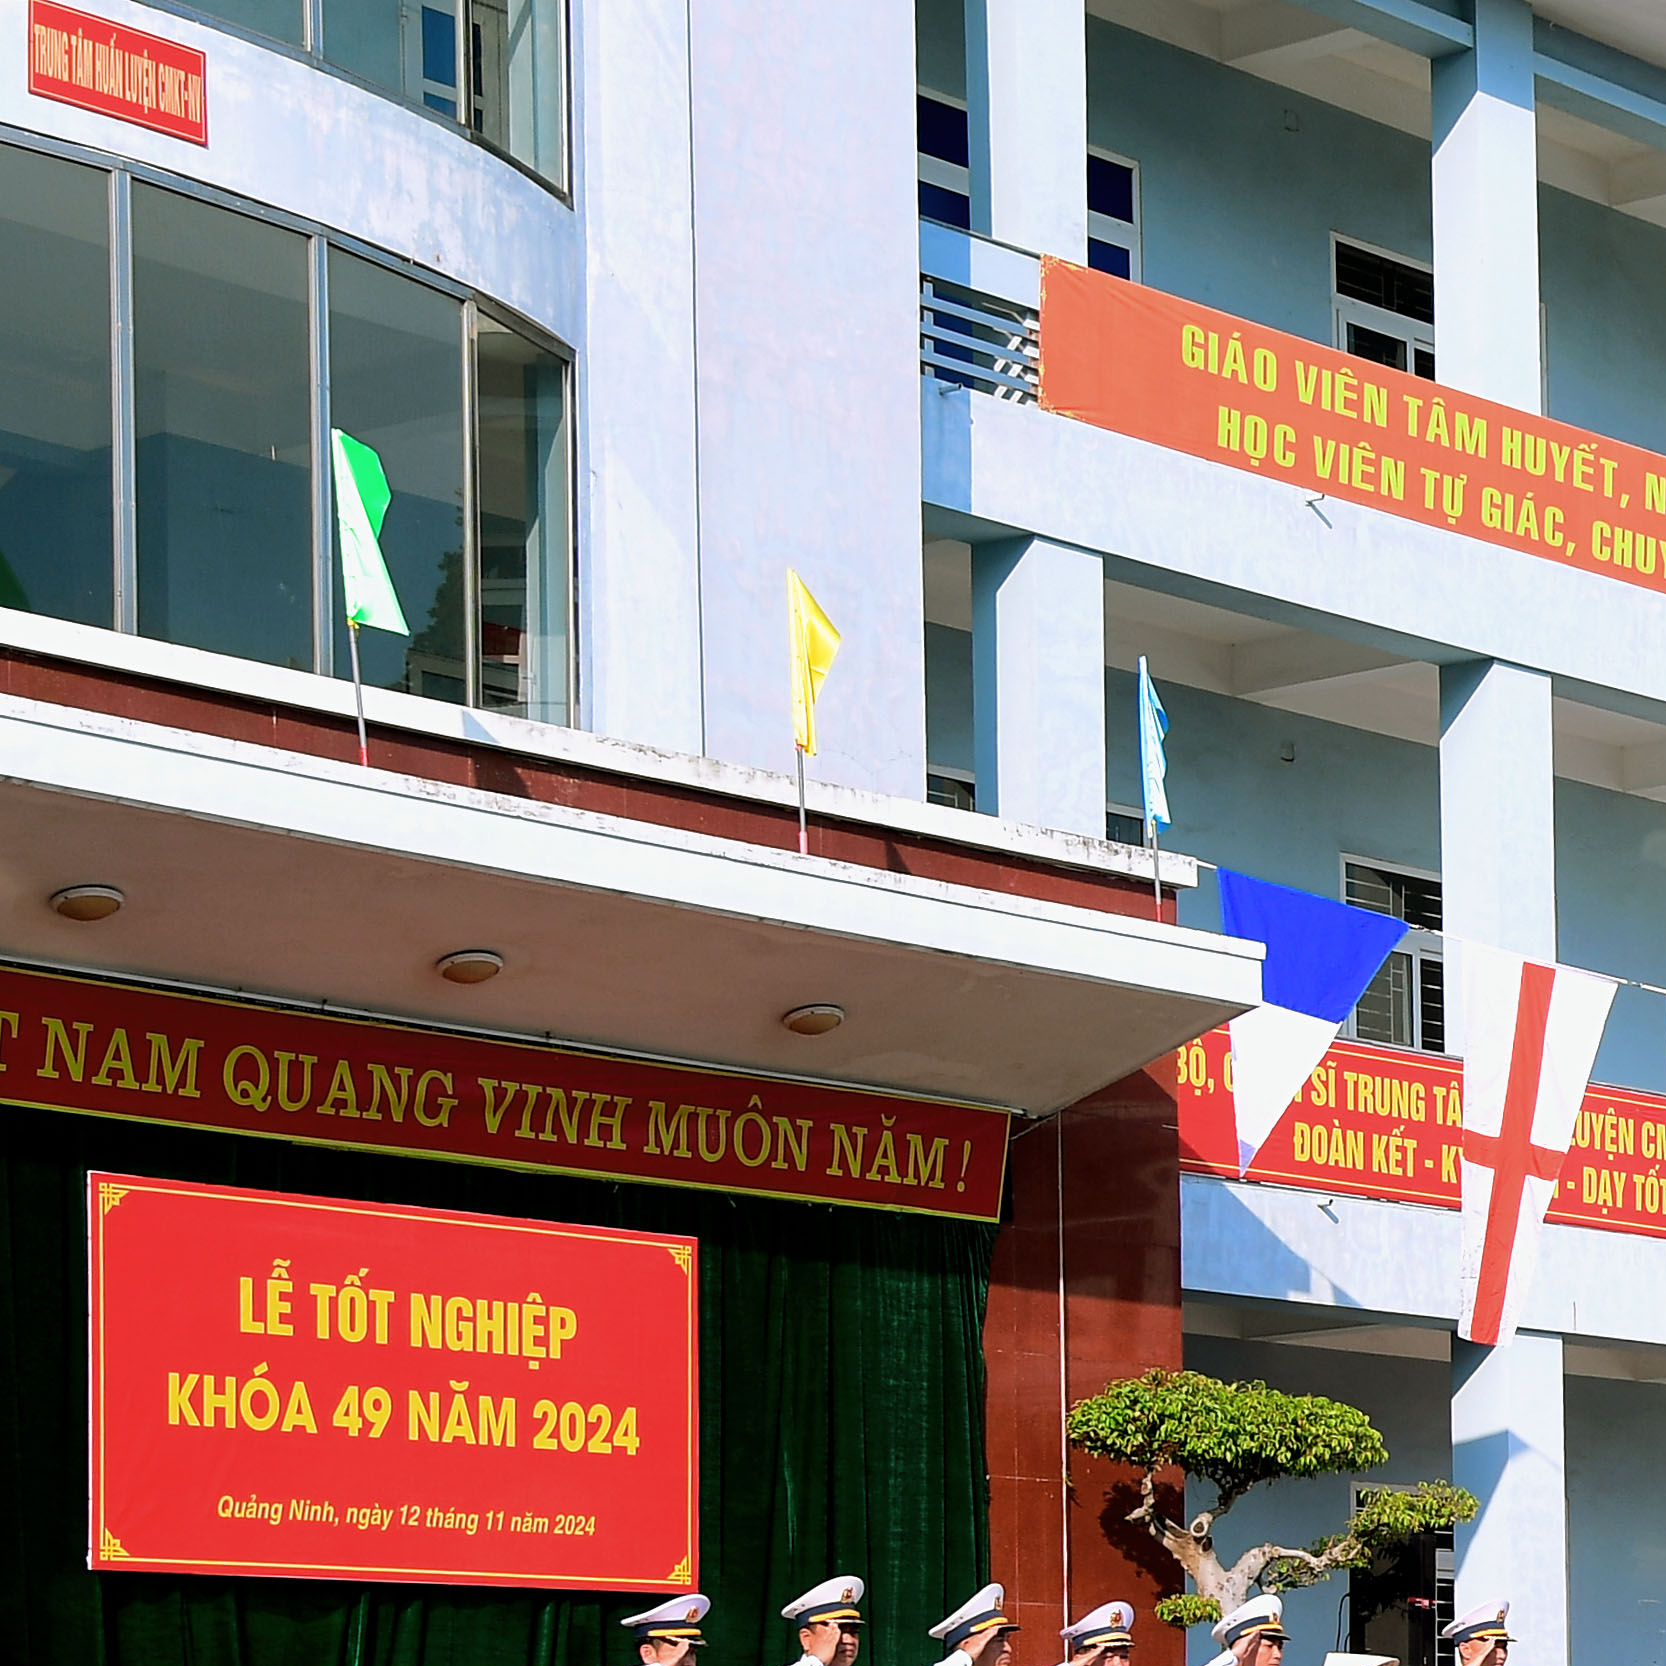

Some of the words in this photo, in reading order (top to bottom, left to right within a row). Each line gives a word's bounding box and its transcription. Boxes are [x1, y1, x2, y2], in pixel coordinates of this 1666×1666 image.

[34, 24, 69, 82] TRUNG
[71, 28, 93, 90] TÂM
[95, 32, 123, 99] HUẤN
[125, 49, 156, 114] LUYỆN
[1182, 324, 1277, 393] GIÁO
[1295, 360, 1388, 428] VIÊN
[1403, 394, 1488, 459] TÂM
[1501, 426, 1630, 509] HUYẾT,
[1217, 405, 1297, 468] HỌC
[1313, 435, 1405, 501] VIÊN
[1420, 467, 1467, 525] TỰ
[1481, 487, 1576, 557] GIÁC,
[36, 1016, 205, 1098] NAM
[222, 1044, 459, 1128] QUANG
[478, 1077, 633, 1151] VINH
[643, 1093, 814, 1172] MUÔN
[1311, 1060, 1337, 1108] SĨ
[1344, 1071, 1426, 1121] TRUNG
[1433, 1080, 1463, 1128] TÂ
[1293, 1119, 1364, 1170] ĐOÀN
[1372, 1125, 1418, 1177] KẾT
[1583, 1166, 1626, 1215] DẠY
[239, 1258, 294, 1337] LỄ
[309, 1267, 395, 1345] TỐT
[410, 1292, 578, 1370] NGHIỆP
[167, 1361, 318, 1434] KHÓA
[332, 1385, 392, 1439] 49
[408, 1379, 516, 1448] NĂM
[532, 1399, 640, 1456] 2024
[217, 1494, 283, 1525] Quảng
[289, 1500, 340, 1527] Ninh,
[346, 1504, 393, 1531] ngày
[399, 1504, 420, 1527] 12
[426, 1507, 478, 1536] tháng
[485, 1510, 504, 1531] 11
[510, 1512, 548, 1534] năm
[553, 1515, 596, 1536] 2024
